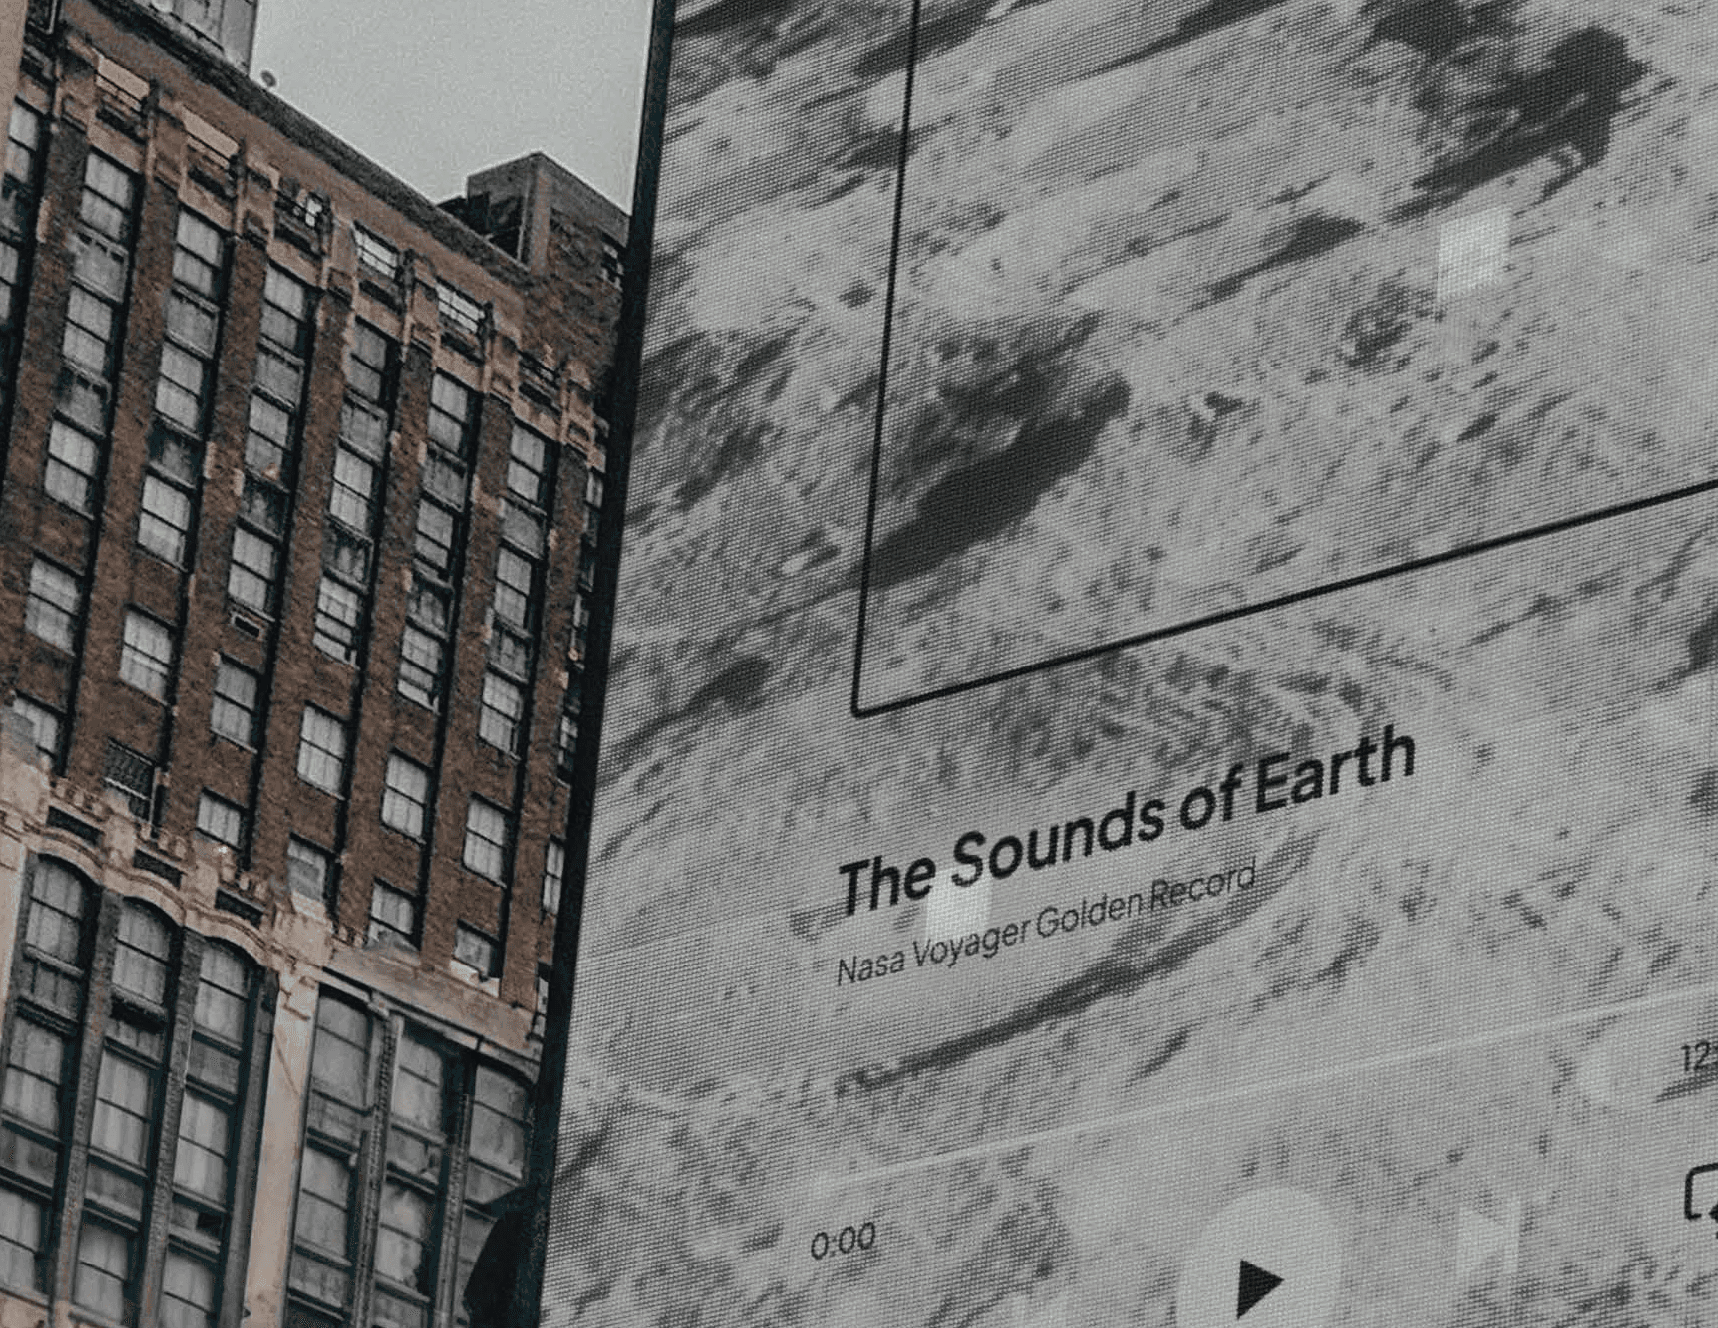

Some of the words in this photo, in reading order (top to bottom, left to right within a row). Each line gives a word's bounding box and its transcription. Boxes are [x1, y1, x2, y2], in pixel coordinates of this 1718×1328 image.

[838, 855, 937, 918] The
[950, 790, 1168, 889] Sounds
[1179, 764, 1244, 831] of
[1255, 723, 1416, 815] Earth
[837, 945, 906, 987] Nasa
[911, 916, 1033, 969] Voyager
[1035, 888, 1145, 939] Golden
[1148, 857, 1257, 912] Record
[809, 1218, 877, 1261] 0:00
